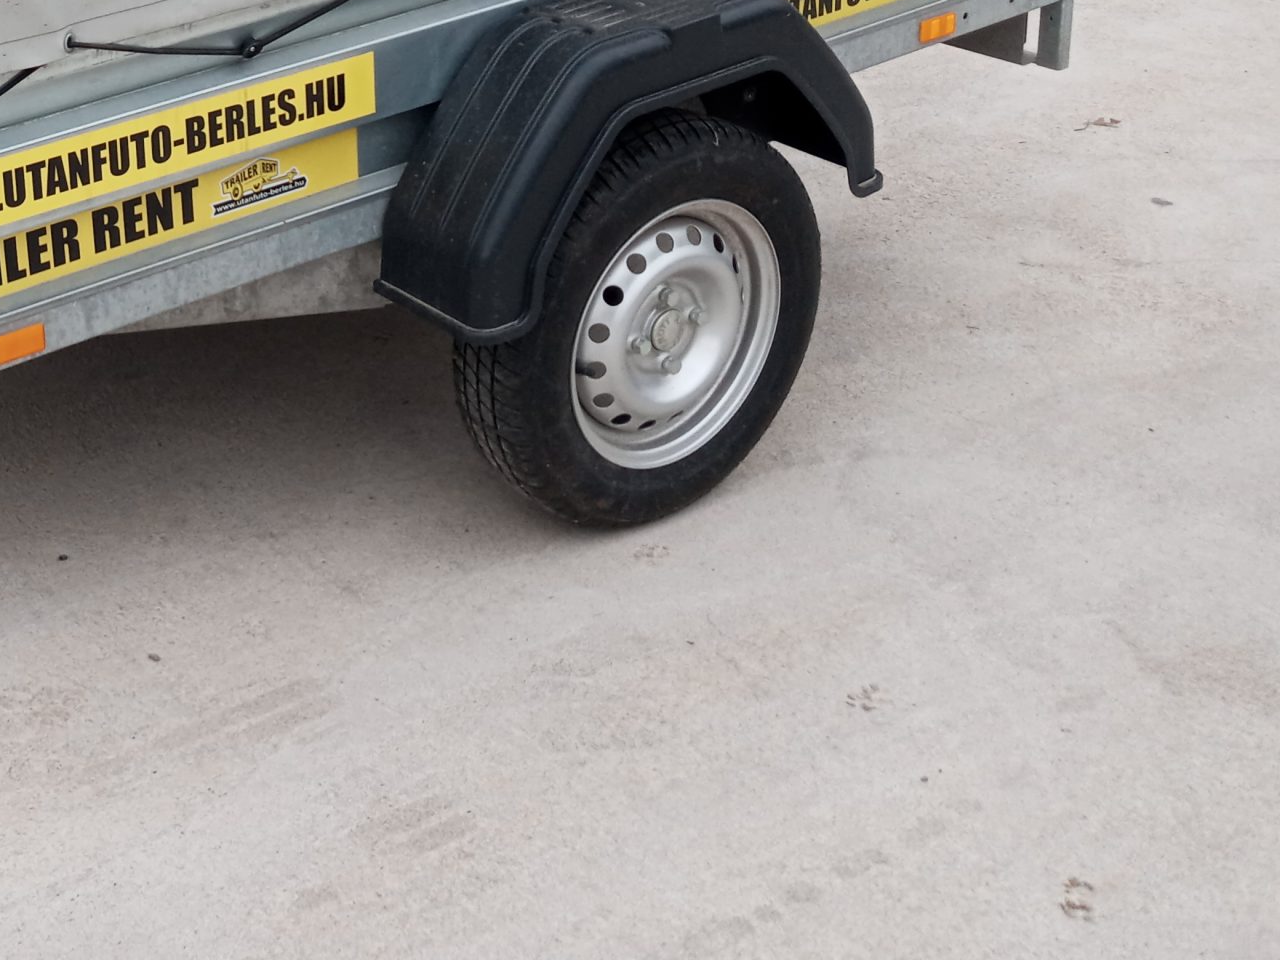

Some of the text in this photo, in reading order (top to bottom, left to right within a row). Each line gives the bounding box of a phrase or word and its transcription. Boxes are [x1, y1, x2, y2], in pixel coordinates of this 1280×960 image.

[224, 162, 277, 189] TRAILER RENT
[91, 178, 200, 251] RENT
